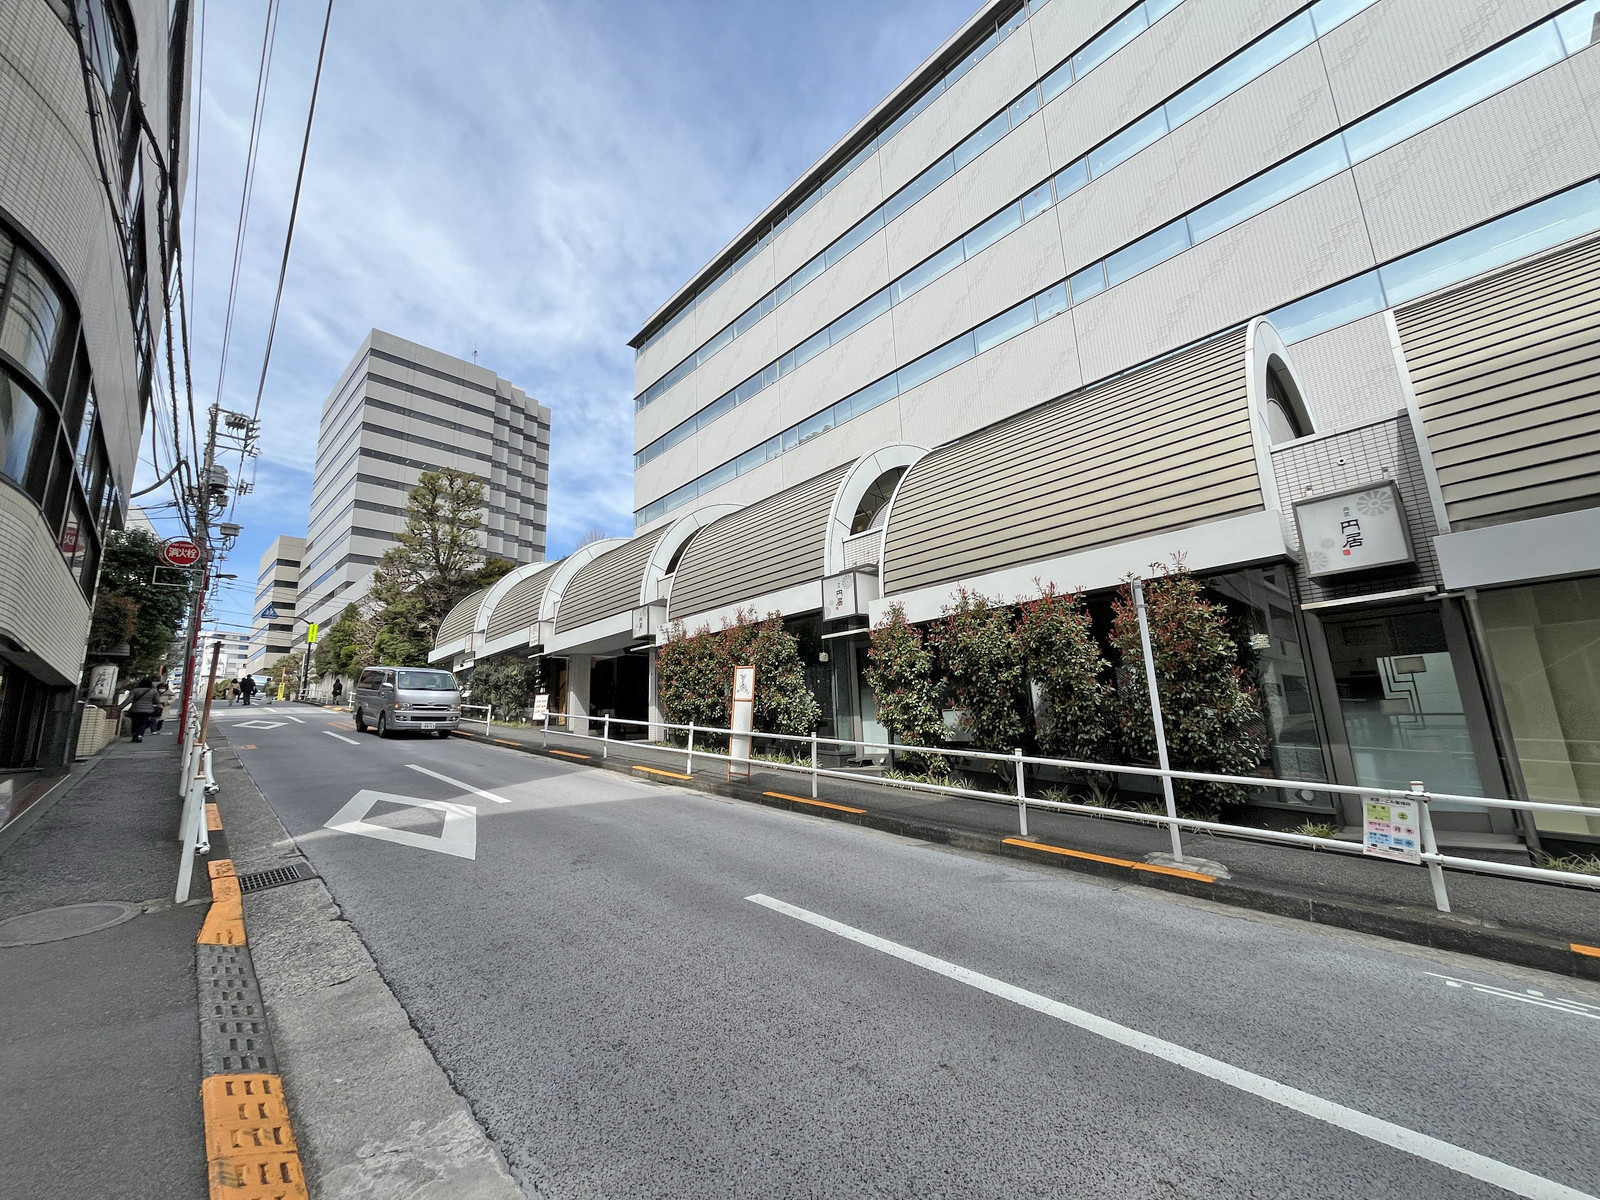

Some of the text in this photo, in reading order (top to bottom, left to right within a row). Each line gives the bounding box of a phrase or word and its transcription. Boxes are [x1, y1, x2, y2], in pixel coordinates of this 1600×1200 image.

[1340, 519, 1363, 548] 円居
[168, 547, 197, 559] 消火栓
